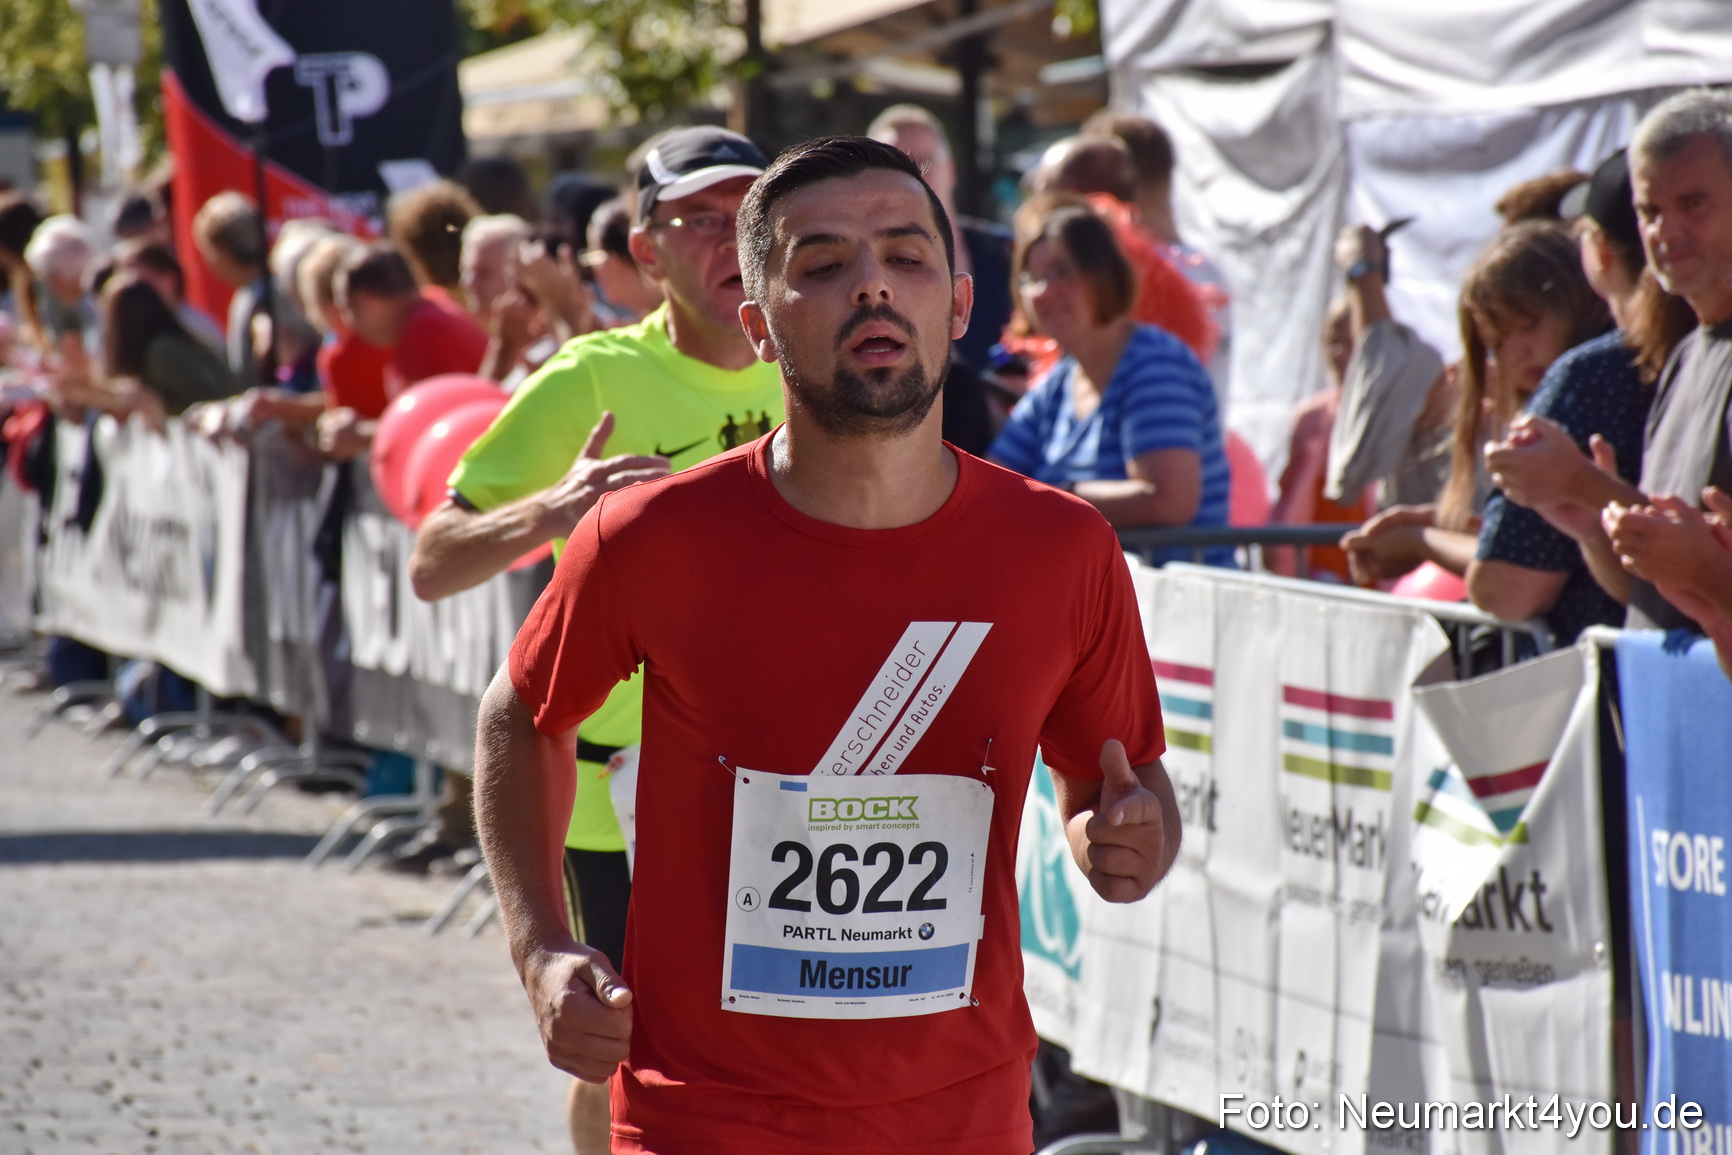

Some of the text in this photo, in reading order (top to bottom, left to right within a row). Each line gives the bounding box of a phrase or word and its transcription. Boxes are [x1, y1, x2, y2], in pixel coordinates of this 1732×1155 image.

[893, 724, 916, 752] und
[910, 684, 946, 725] Autos.
[809, 796, 919, 822] BOCK
[808, 822, 920, 832] inspired by smart concepts
[768, 841, 949, 915] 2622
[743, 893, 752, 906] A
[783, 925, 912, 941] PARTL Neumarkt
[800, 959, 912, 989] Mensur
[1661, 971, 1732, 1041] NLIN
